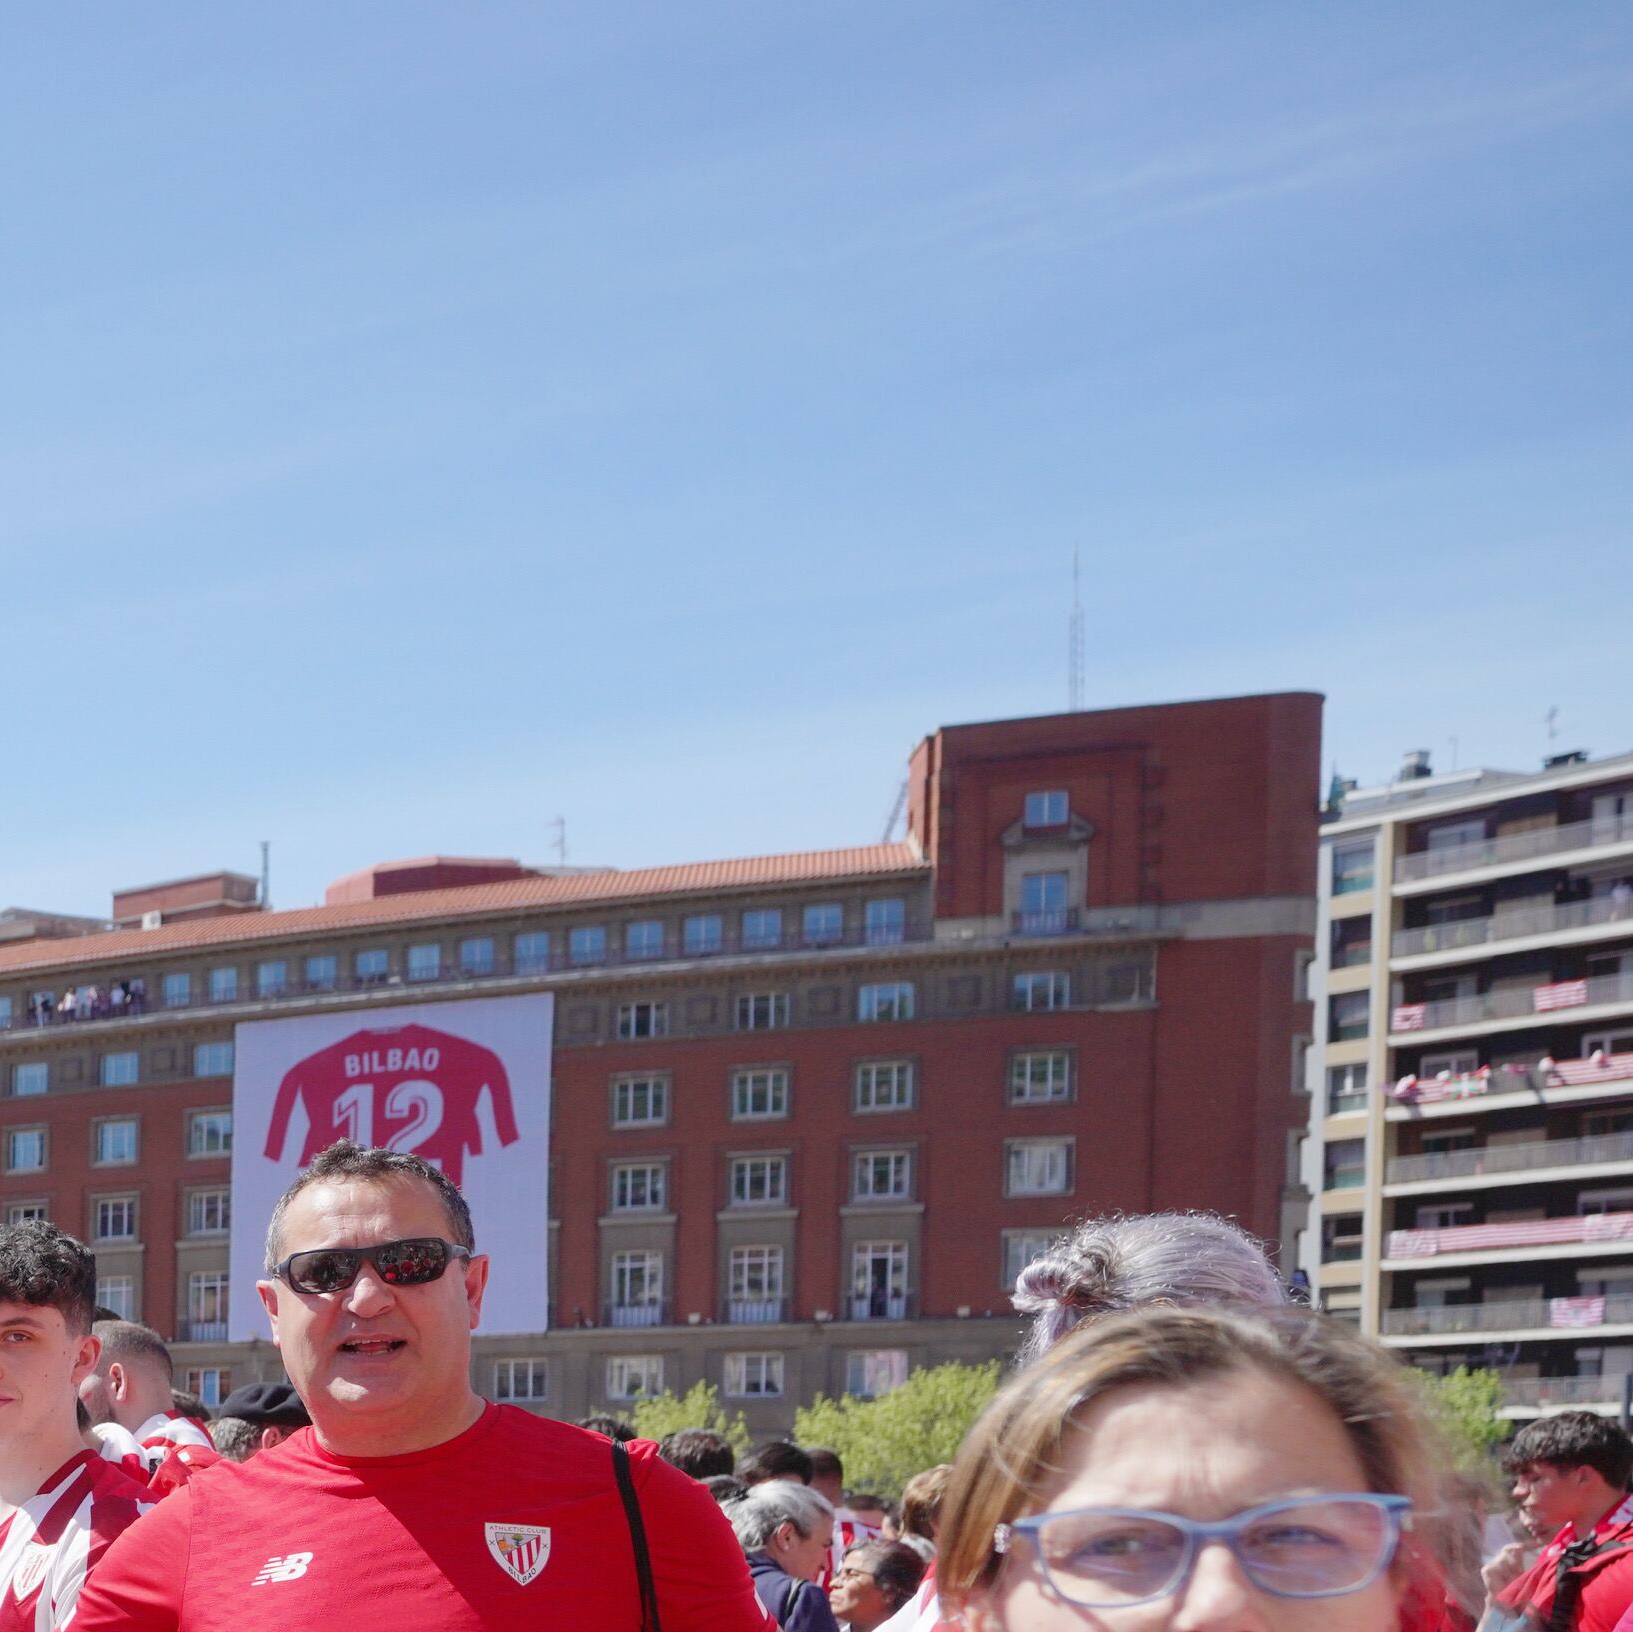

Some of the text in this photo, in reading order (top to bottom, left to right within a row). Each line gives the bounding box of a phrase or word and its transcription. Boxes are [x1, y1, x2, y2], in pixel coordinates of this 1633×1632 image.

[344, 1048, 440, 1078] BILBAO
[332, 1079, 444, 1151] 12
[489, 1525, 547, 1535] ATHLETIC CLUB
[507, 1566, 537, 1584] BILBAO
